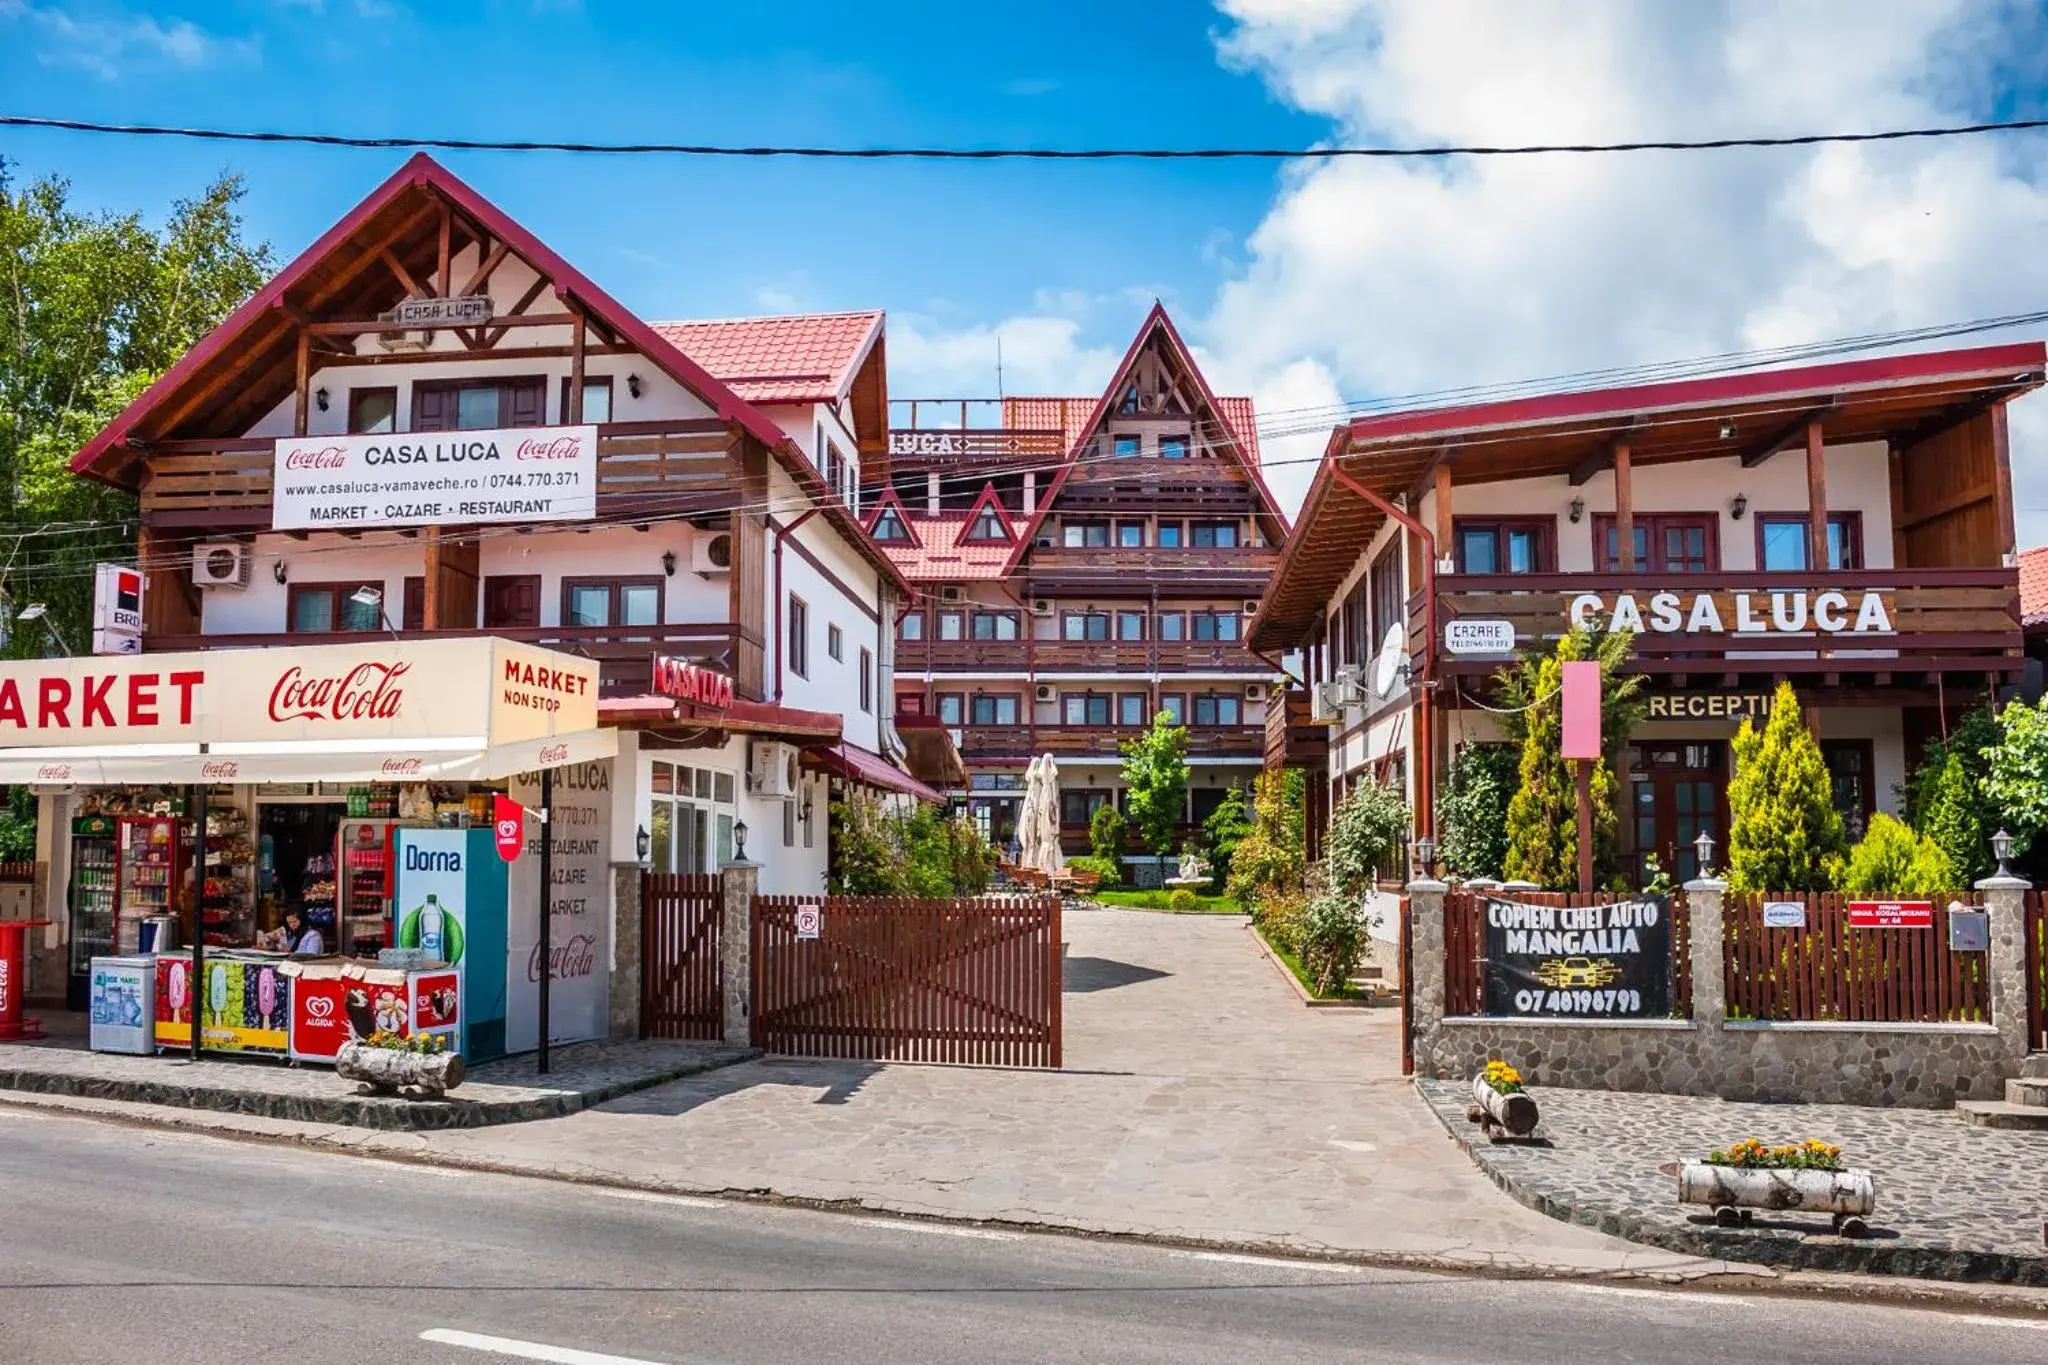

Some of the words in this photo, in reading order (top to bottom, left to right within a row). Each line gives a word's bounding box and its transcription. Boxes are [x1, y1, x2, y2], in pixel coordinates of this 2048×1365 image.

[404, 306, 440, 320] CASA
[446, 303, 481, 317] LUCA
[365, 445, 428, 465] CASA
[436, 441, 500, 462] LUCA
[517, 436, 582, 461] Coca-Cola
[889, 433, 954, 454] LUCA
[286, 447, 349, 470] Coca-Cola
[286, 477, 479, 496] www.casaluca-vamaveche.ro
[490, 471, 579, 488] 0744.770.371
[310, 506, 367, 520] MARKET
[385, 502, 442, 518] CAZARE
[459, 499, 552, 515] RESTAURANT
[114, 612, 140, 627] BRD
[1570, 592, 1724, 633] CASA
[1736, 592, 1892, 633] LUCA
[1453, 625, 1502, 638] CAZARE
[505, 659, 588, 696] MARKET
[656, 656, 700, 701] CASA
[701, 668, 733, 710] LUCA
[0, 671, 204, 728] ARKET
[268, 661, 413, 722] Coca-Cola
[504, 689, 530, 707] NON
[531, 695, 560, 712] STOP
[202, 760, 238, 778] Coca-Cola
[567, 762, 609, 792] LUCA
[406, 844, 461, 872] Dorna
[528, 839, 599, 855] RETAURANT
[551, 868, 587, 885] AZARE
[551, 898, 587, 915] ARKET
[1489, 902, 1556, 930] COPIEM
[1560, 906, 1604, 931] CHEI
[1608, 899, 1659, 929] AUTO
[1506, 928, 1641, 955] MANGALIA
[306, 1018, 334, 1028] ALGIDA
